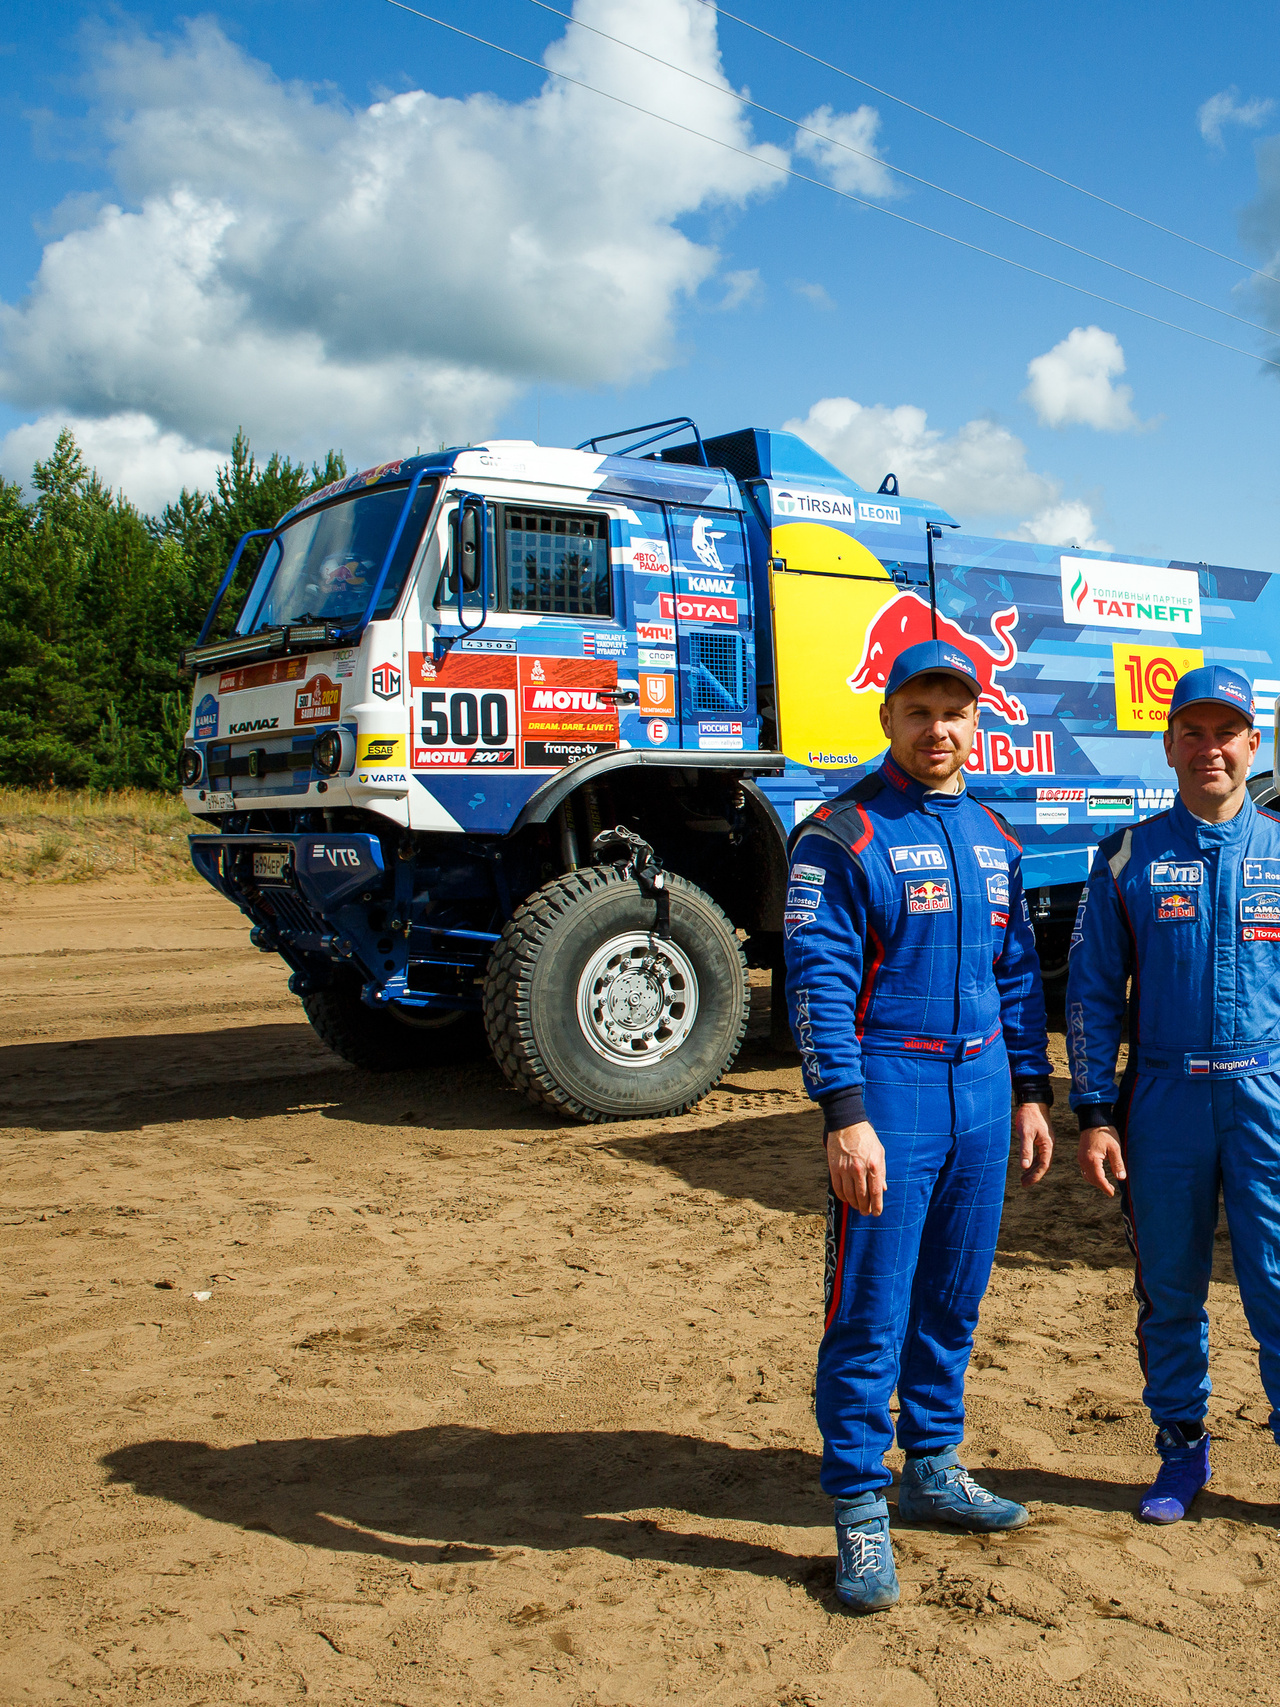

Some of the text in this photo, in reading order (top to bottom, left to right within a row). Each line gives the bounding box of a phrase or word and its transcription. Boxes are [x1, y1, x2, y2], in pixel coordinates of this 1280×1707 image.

[861, 506, 899, 521] LEONI
[633, 552, 657, 562] АВТО
[640, 561, 669, 573] РАДИО
[688, 576, 735, 594] KAMAZ
[1092, 588, 1193, 605] ТОПЛИВНЫЙ ПАРТНЕР
[663, 597, 735, 619] TOTAL
[1093, 599, 1193, 623] TATNEFT
[466, 641, 512, 649] 43509
[649, 652, 674, 660] СПОРТ
[322, 690, 339, 706] 2020
[195, 714, 217, 727] KAMAZ
[421, 691, 508, 745] 500
[229, 717, 279, 735] KAMAZ
[528, 722, 560, 731] DREAM.
[561, 723, 585, 731] DARE.
[701, 724, 742, 733] РОССИЯ 24
[368, 746, 393, 754] ESAB
[989, 733, 1054, 774] Bull
[416, 752, 513, 763] MOTUL 300V
[809, 752, 858, 764] Webasto
[371, 774, 406, 782] VARTA
[1038, 790, 1084, 801] LOCTITE
[326, 849, 361, 867] VTB
[909, 851, 943, 866] VTB
[1169, 867, 1200, 881] VTB
[793, 897, 817, 906] Rostec
[911, 899, 949, 911] Red Bull
[1158, 906, 1195, 918] Red Bull
